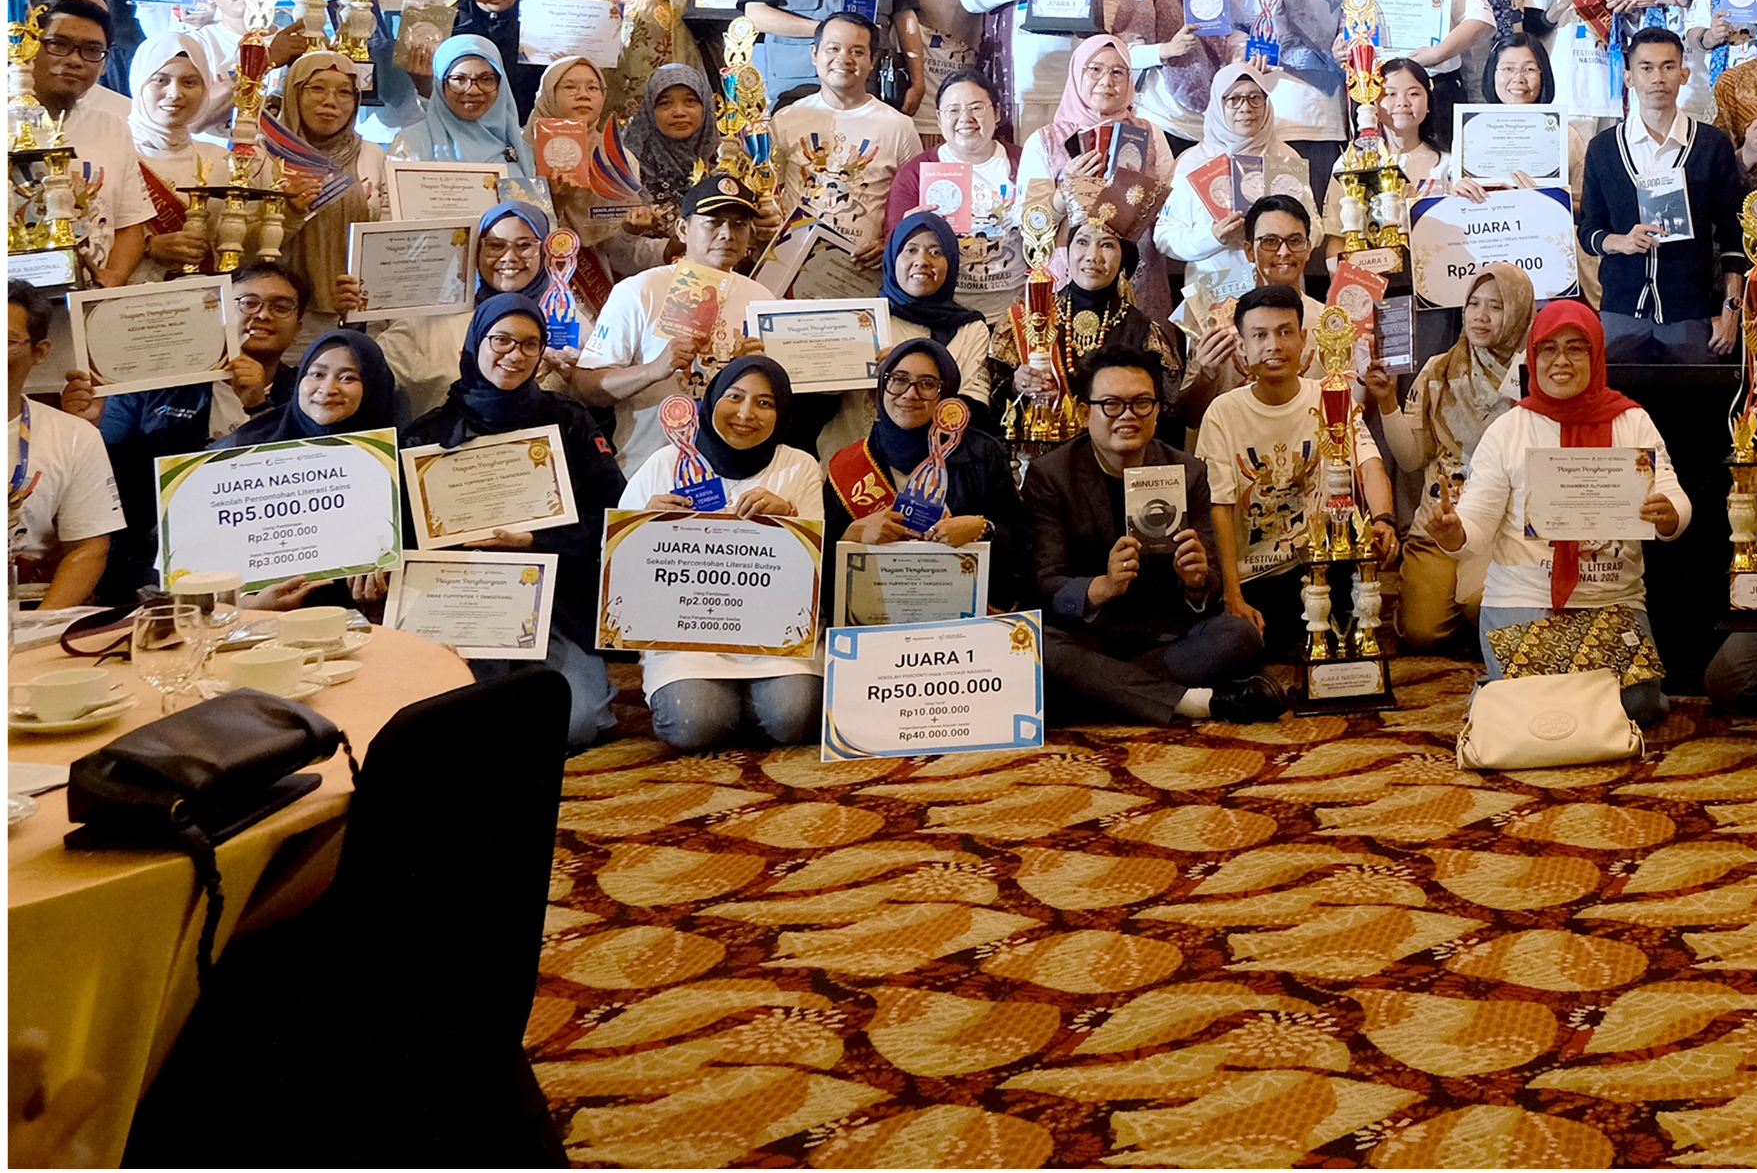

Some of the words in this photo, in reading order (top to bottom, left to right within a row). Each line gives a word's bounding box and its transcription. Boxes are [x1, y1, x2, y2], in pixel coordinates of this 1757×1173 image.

[924, 57, 957, 70] FESTIVAL
[1464, 221, 1511, 236] JUARA
[1515, 220, 1522, 231] 1
[1358, 258, 1382, 267] JUARA
[1447, 256, 1543, 279] Rp2000
[980, 272, 1012, 282] LITERASI
[477, 457, 521, 469] Penghargaan
[499, 471, 532, 480] TANGERANG
[1557, 466, 1581, 475] Piagam
[1581, 466, 1624, 475] Penghargaan
[212, 478, 264, 495] JUARA
[269, 467, 348, 487] NASIONAL
[1131, 478, 1180, 488] MINUSTIGA
[210, 497, 243, 509] Sekolah
[245, 491, 296, 504] Percontohan
[297, 485, 328, 497] Literasi
[329, 483, 351, 492] Sains
[218, 493, 345, 527] Rp5.000.000
[899, 504, 914, 517] 10
[248, 525, 318, 544] Rp2.000.000
[652, 541, 701, 555] JUARA
[704, 543, 777, 558] NASIONAL
[249, 549, 319, 568] Rp3.000.000
[646, 557, 676, 566] Sekolah
[677, 559, 724, 568] Percontohan
[726, 560, 753, 570] Literasi
[754, 562, 782, 572] Budaya
[1244, 554, 1284, 564] FESTIVAL
[904, 566, 948, 575] Penghargaan
[1587, 561, 1624, 572] LITERASI
[461, 577, 508, 587] Penghargaan
[654, 568, 771, 587] Rp5.000.000
[1600, 572, 1620, 583] 2026
[679, 596, 743, 608] Rp2.000.000
[677, 620, 742, 632] Rp3.000.000
[894, 650, 960, 669] JUARA
[966, 649, 974, 663] 1
[1341, 673, 1373, 681] NASIONAL
[867, 677, 1003, 703] Rp50.000.000
[899, 704, 970, 719] Rp10.000.000
[898, 728, 970, 742] Rp40.000.000
